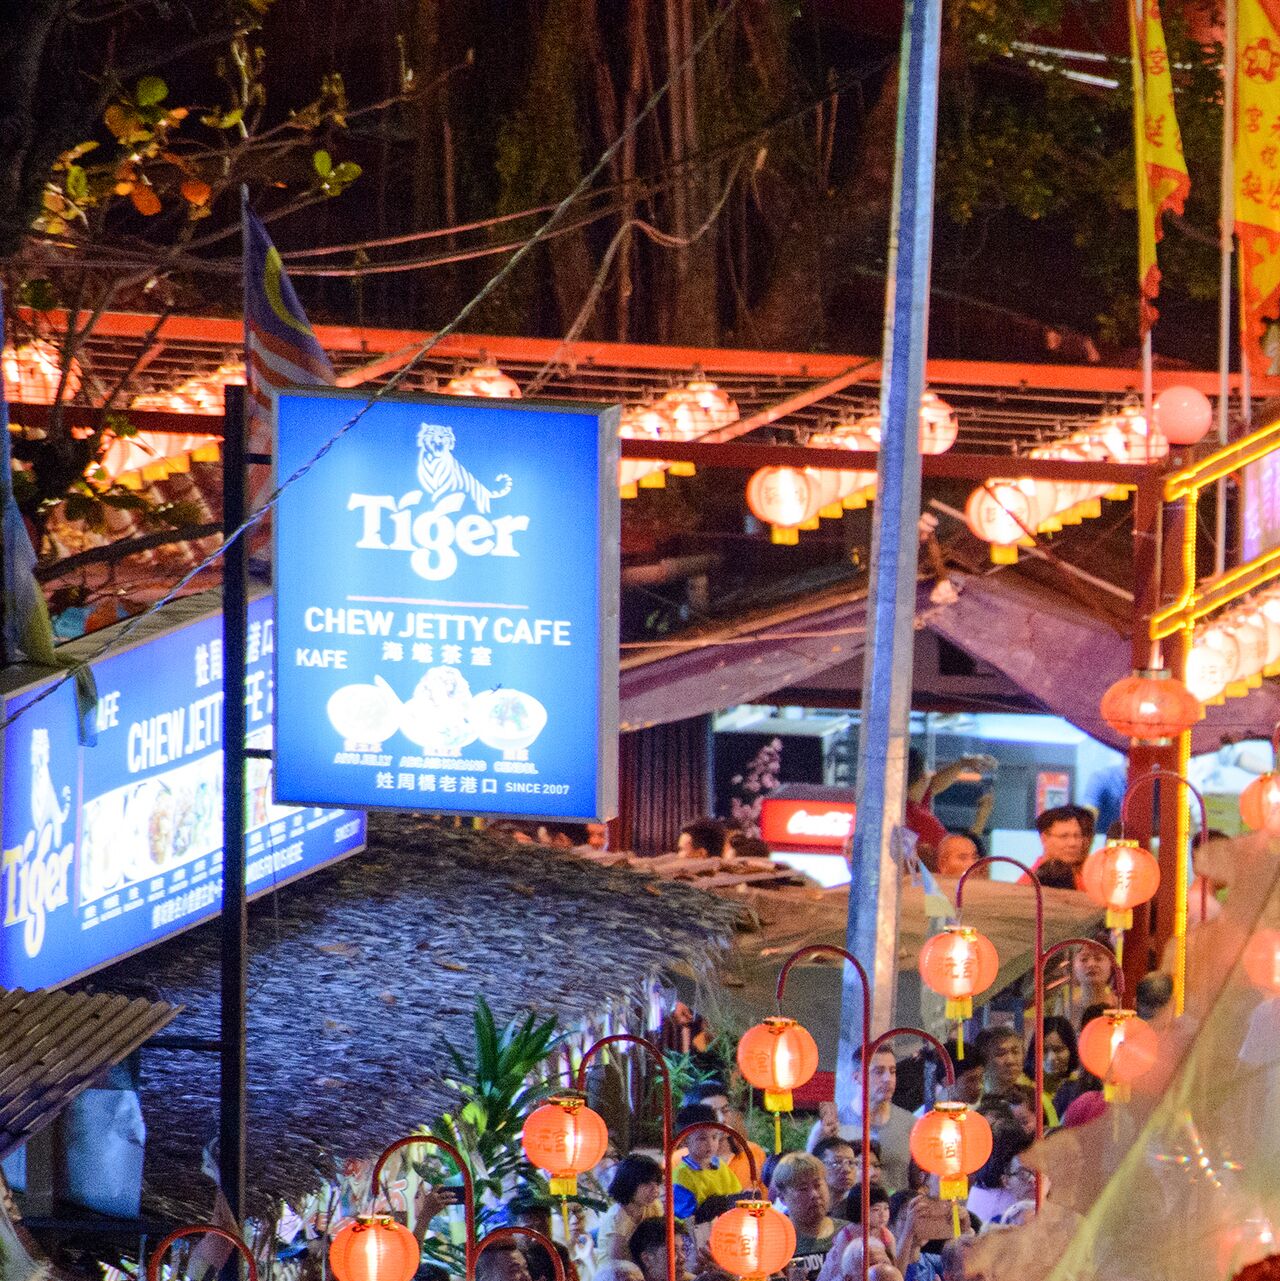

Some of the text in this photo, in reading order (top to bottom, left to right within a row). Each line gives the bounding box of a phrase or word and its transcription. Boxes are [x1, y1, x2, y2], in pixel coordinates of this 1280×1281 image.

[346, 488, 530, 581] Tiger
[303, 606, 571, 646] CHEW JETTY CAFE
[295, 647, 348, 669] KAFE
[96, 690, 121, 732] AFE
[127, 706, 185, 774] CHEW
[185, 690, 224, 755] JETT
[376, 771, 498, 794] 姓周橋老港口
[505, 782, 570, 795] SINCE 2007
[3, 823, 74, 958] Tiger
